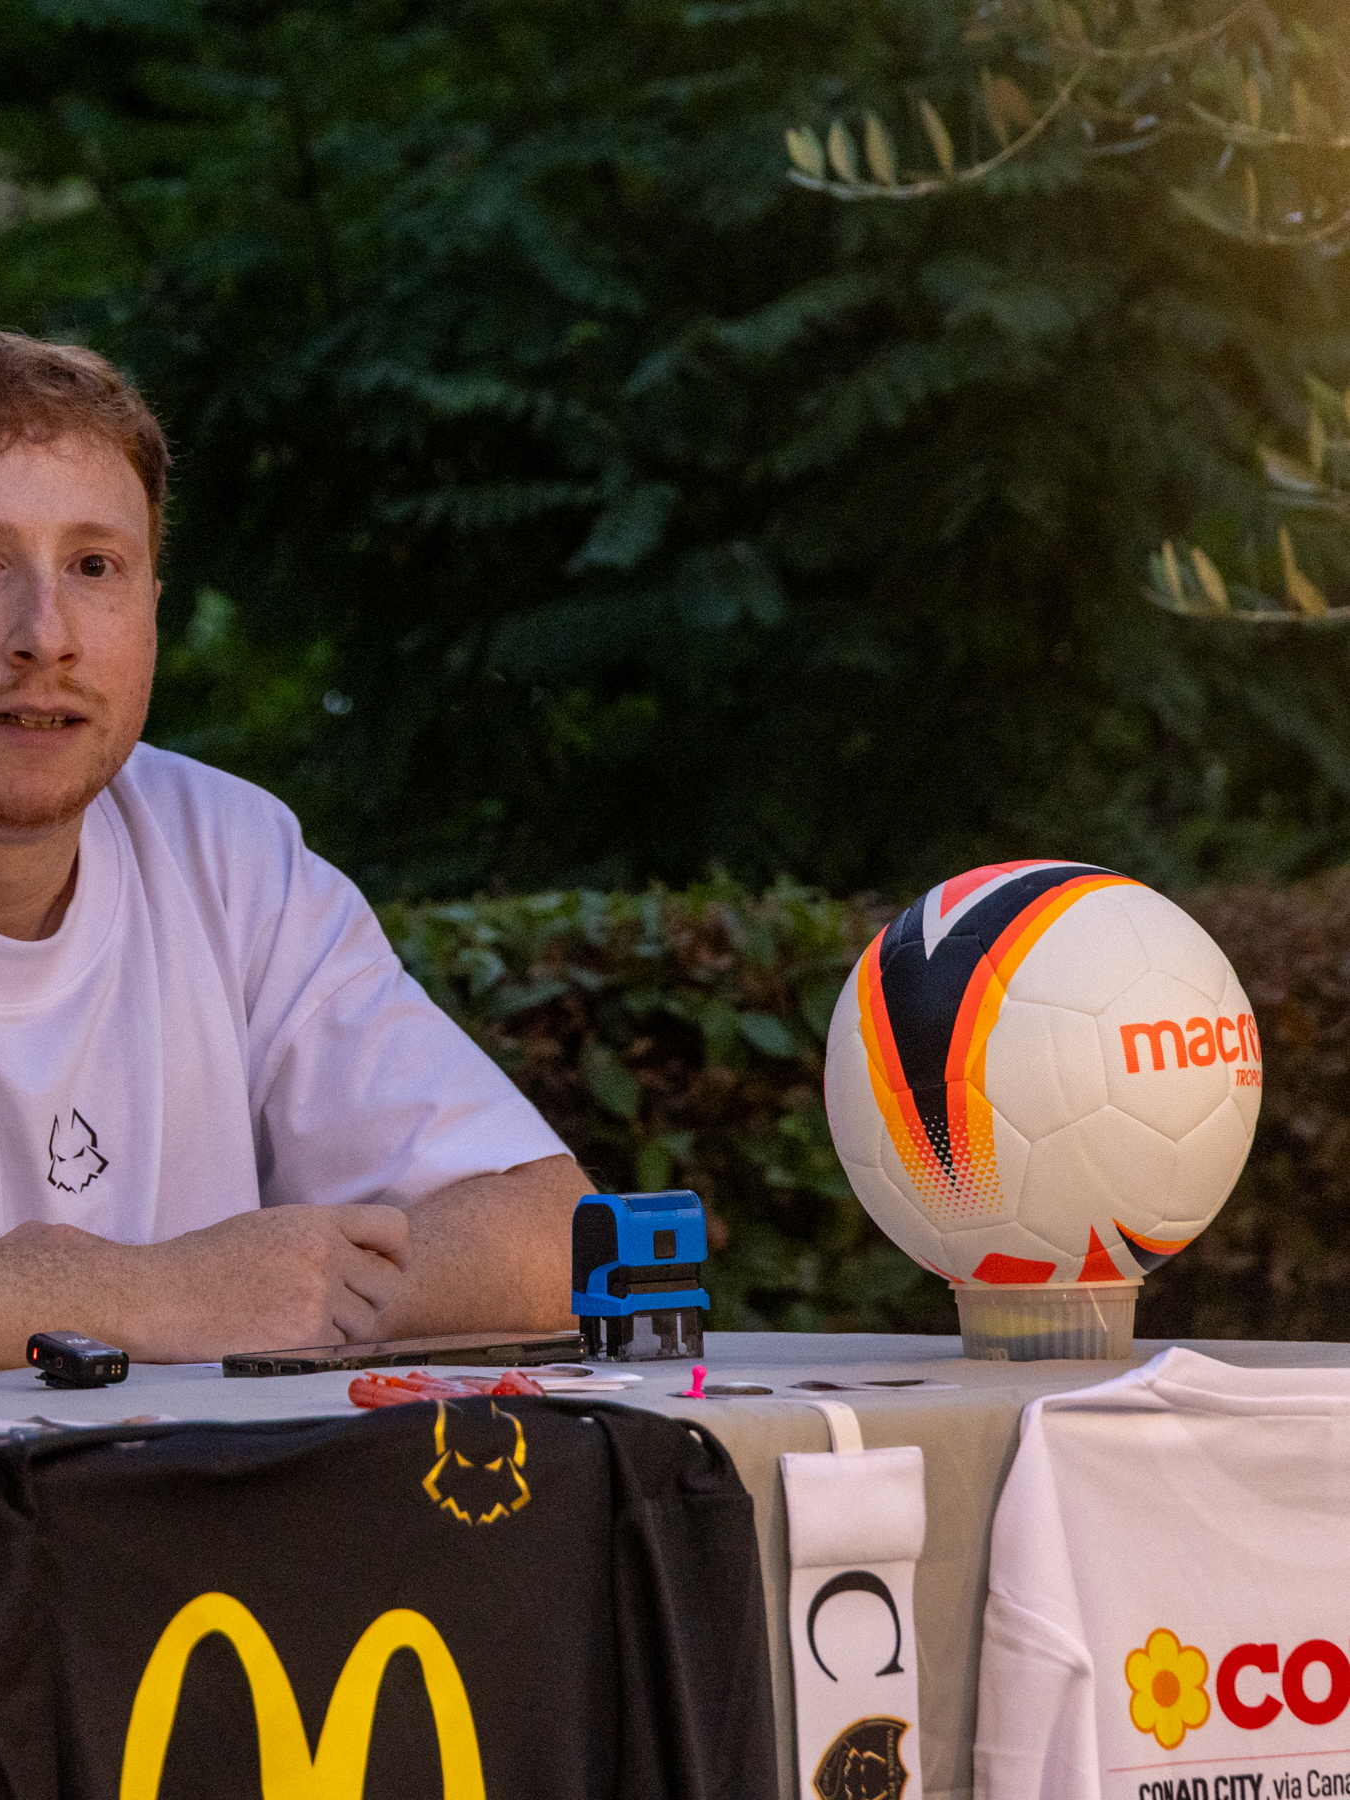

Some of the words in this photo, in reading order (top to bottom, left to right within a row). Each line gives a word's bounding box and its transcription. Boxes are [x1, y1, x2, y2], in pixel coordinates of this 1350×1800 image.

[807, 1570, 904, 1682] C
[1216, 1639, 1350, 1730] CO
[1139, 1777, 1209, 1800] CONAD
[1273, 1771, 1302, 1800] via
